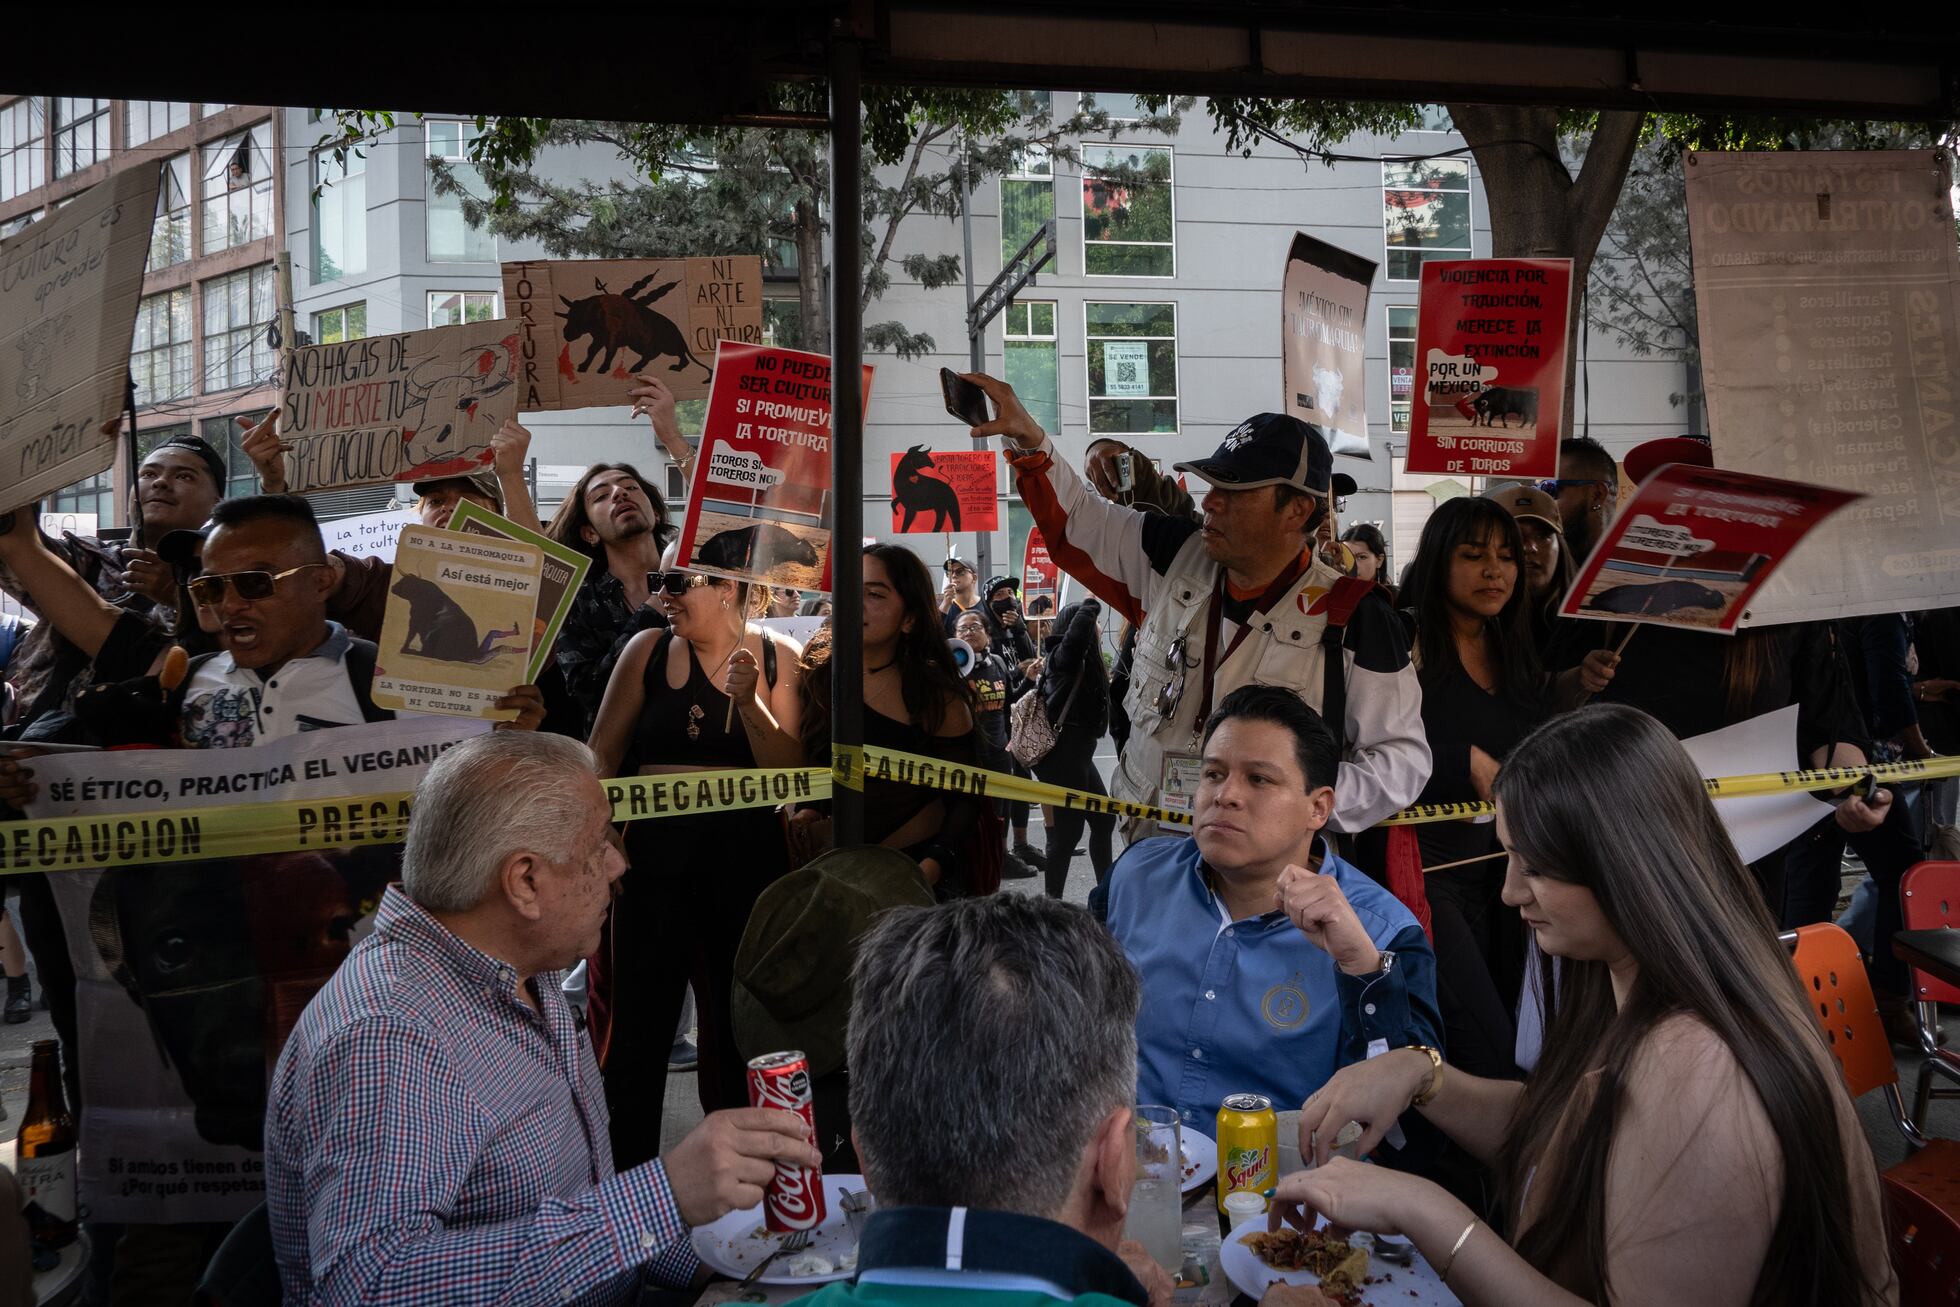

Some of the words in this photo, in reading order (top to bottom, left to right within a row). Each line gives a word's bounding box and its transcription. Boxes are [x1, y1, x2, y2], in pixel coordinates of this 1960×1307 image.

[712, 260, 733, 280] NI
[1440, 268, 1510, 285] VIOLENCIA
[1515, 269, 1549, 284] POR
[697, 283, 744, 304] ARTE
[1462, 288, 1543, 309] TRADICIÓN,
[716, 306, 733, 326] NI
[1338, 304, 1353, 327] SIN
[513, 262, 541, 408] TORTURA
[696, 325, 761, 351] CULTURA
[1456, 320, 1517, 335] MERECE
[1526, 320, 1542, 335] LA
[1464, 339, 1540, 358] EXTINCIÓN
[287, 348, 319, 390] NO
[322, 340, 380, 386] HAGAS
[388, 335, 411, 374] DE
[755, 356, 777, 371] NO
[1430, 363, 1459, 377] POR
[1463, 363, 1481, 376] UN
[740, 375, 771, 395] SER
[774, 381, 831, 404] CULTUR
[284, 392, 310, 433] SU
[312, 381, 386, 431] MUERTE
[387, 380, 407, 421] TU
[736, 399, 749, 413] SI
[20, 417, 94, 477] matar
[736, 423, 752, 439] LA
[758, 426, 828, 452] TORTURA
[1437, 436, 1456, 449] SIN
[1461, 439, 1524, 453] CORRIDAS
[711, 466, 756, 482] TOREROS
[1447, 460, 1465, 472] DE
[1471, 457, 1510, 474] TOROS
[337, 531, 352, 540] La
[352, 543, 364, 552] es
[370, 534, 400, 549] cultu
[410, 537, 423, 546] NO
[441, 542, 453, 551] LA
[459, 545, 525, 563] TAUROMAQUIA
[441, 567, 462, 580] Así
[465, 571, 490, 585] está
[494, 579, 530, 591] mejor
[380, 681, 393, 690] LA
[400, 683, 443, 696] TORTURA
[449, 690, 462, 698] NO
[468, 692, 480, 700] ES
[486, 694, 502, 702] AR
[428, 701, 472, 712] CULTURA
[50, 776, 74, 801] SÉ
[82, 774, 168, 803] ÉTICO,
[180, 763, 295, 797] PRACTICA
[305, 757, 337, 781] EL
[342, 739, 463, 775] VEGANI
[607, 772, 811, 817] PRECAUCION
[298, 800, 411, 845] PRECA
[109, 1158, 123, 1173] Si
[128, 1160, 178, 1175] ambos
[183, 1158, 236, 1174] tienen
[242, 1158, 265, 1173] de
[1226, 1144, 1269, 1192] Squirt
[122, 1178, 153, 1197] ¿Por
[156, 1177, 187, 1199] qué
